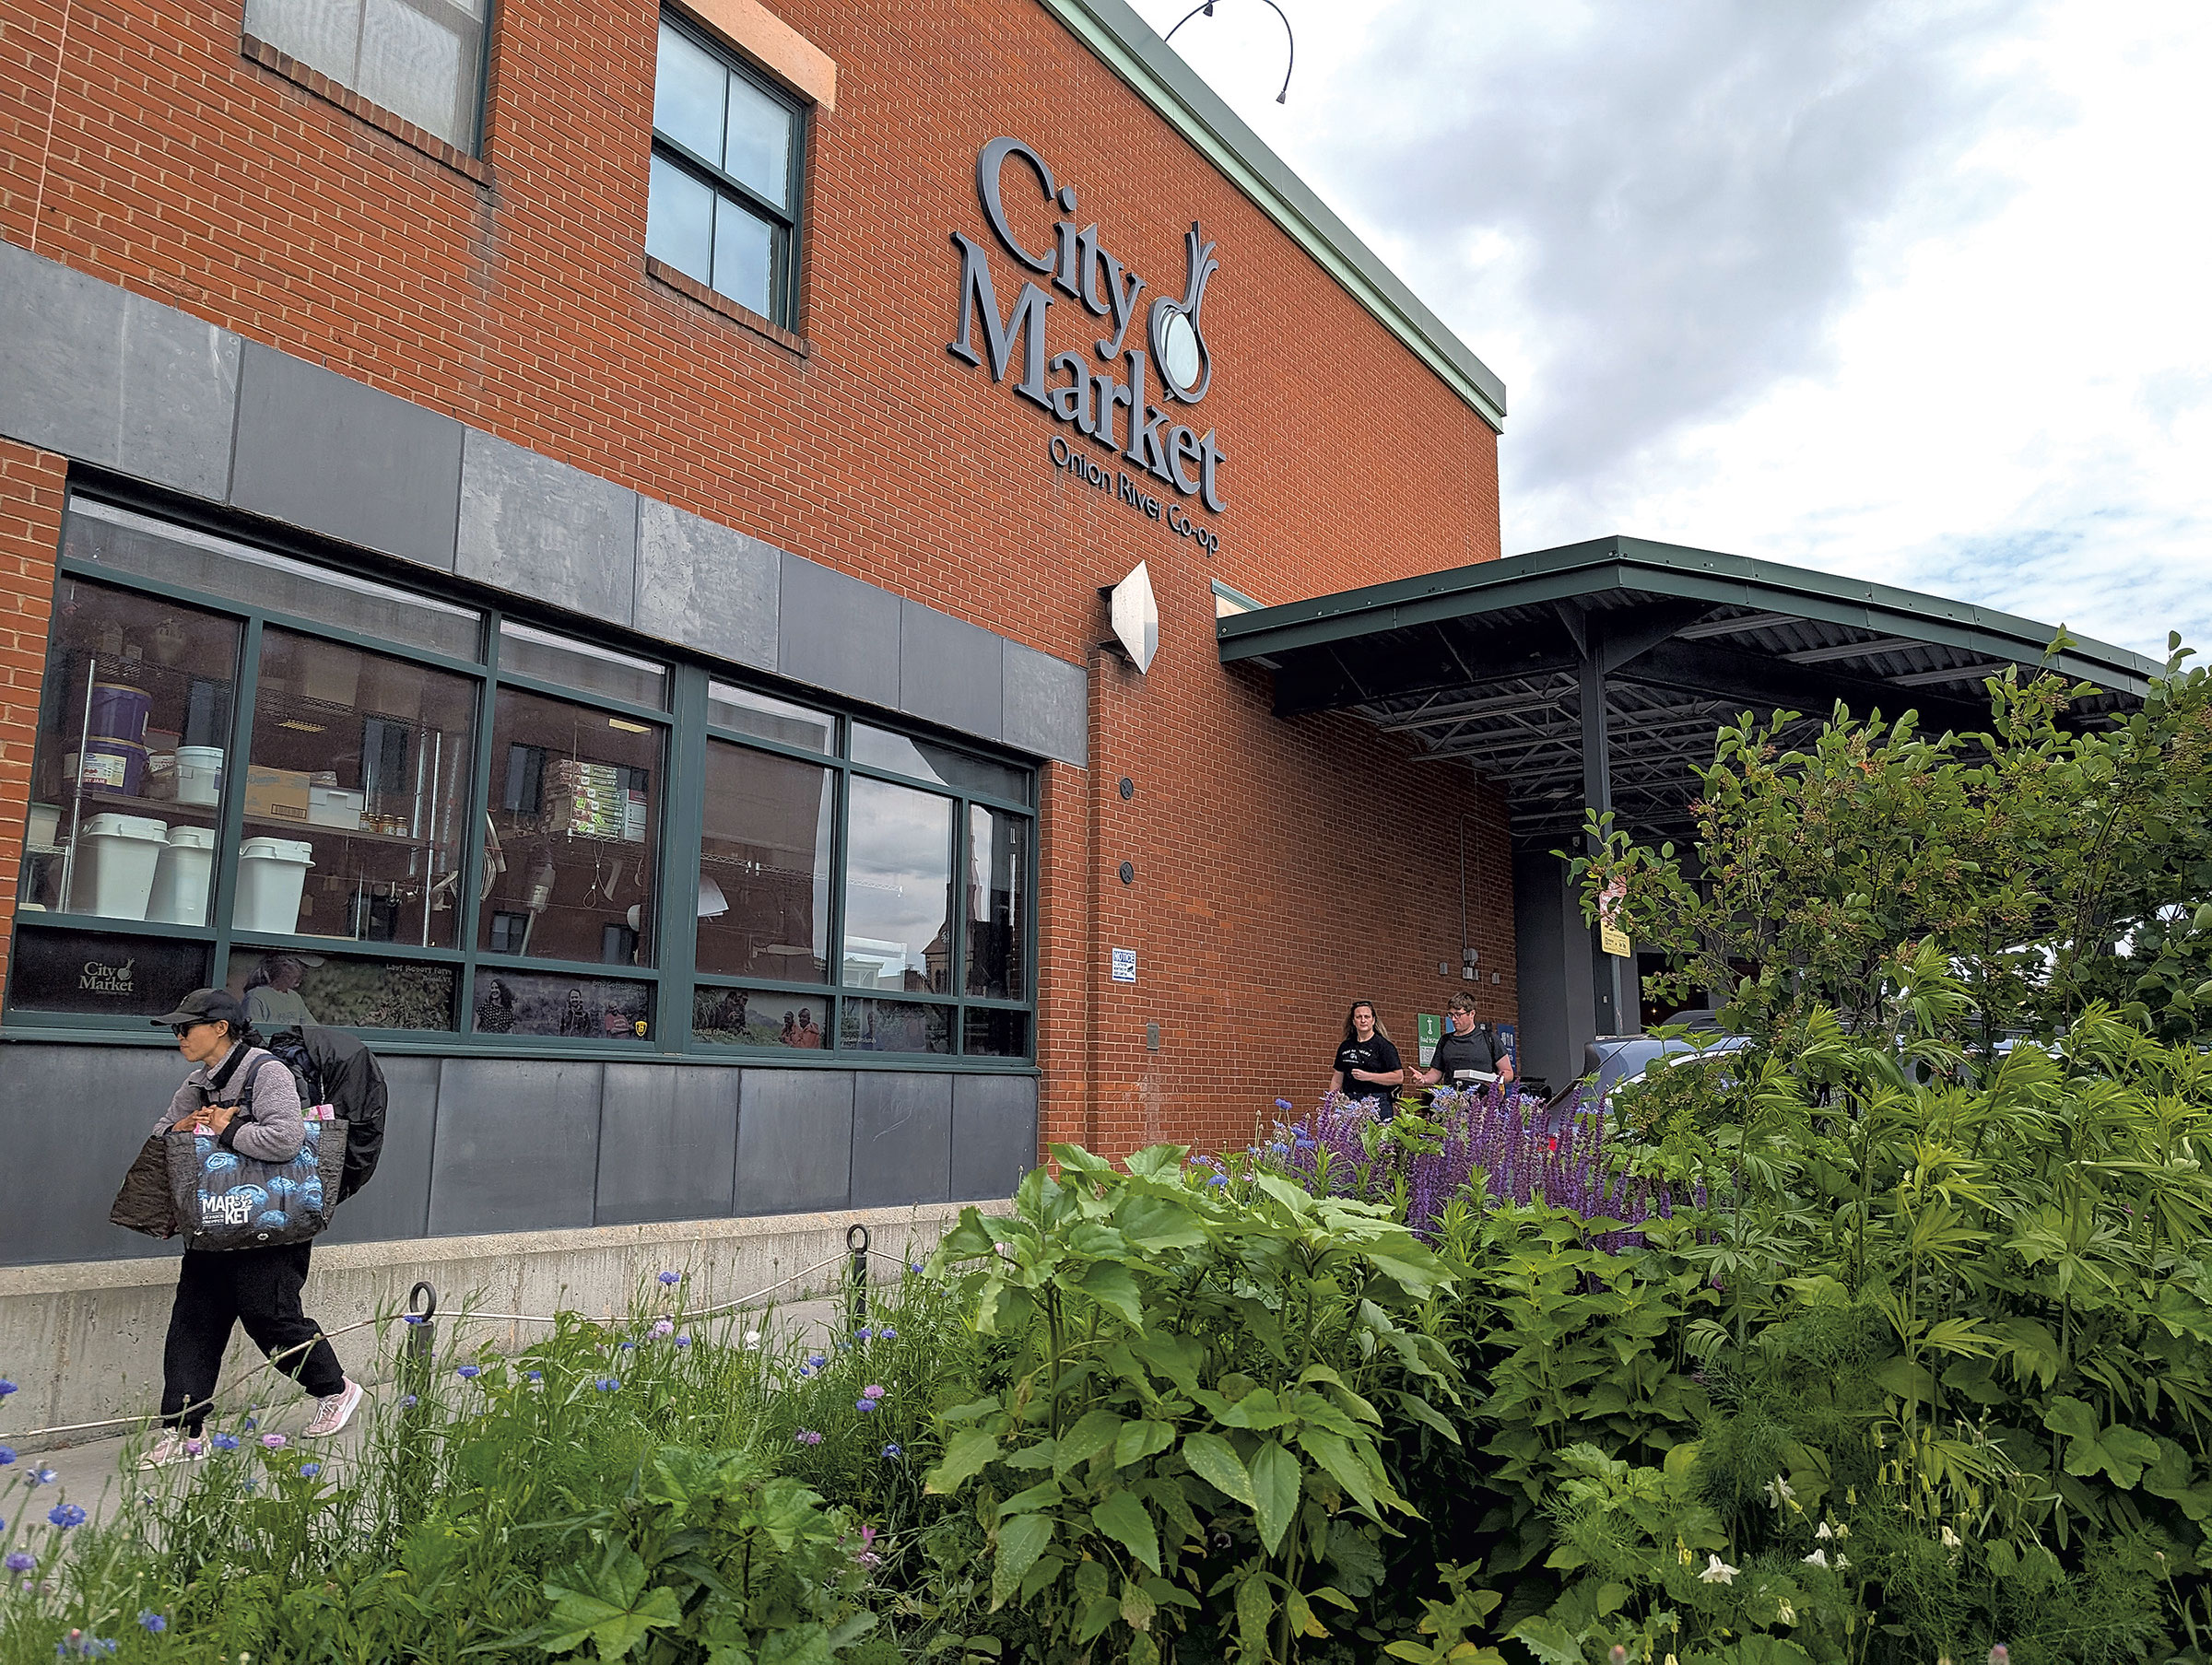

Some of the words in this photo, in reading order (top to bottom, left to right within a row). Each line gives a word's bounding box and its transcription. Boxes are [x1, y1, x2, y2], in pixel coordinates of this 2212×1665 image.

[976, 135, 1147, 360] City
[946, 229, 1228, 513] Market
[1049, 435, 1112, 494] Onion
[1118, 471, 1163, 522] River
[1168, 503, 1219, 557] Co-op
[78, 975, 135, 991] Market
[84, 961, 117, 981] City
[1113, 951, 1135, 963] NOTICE
